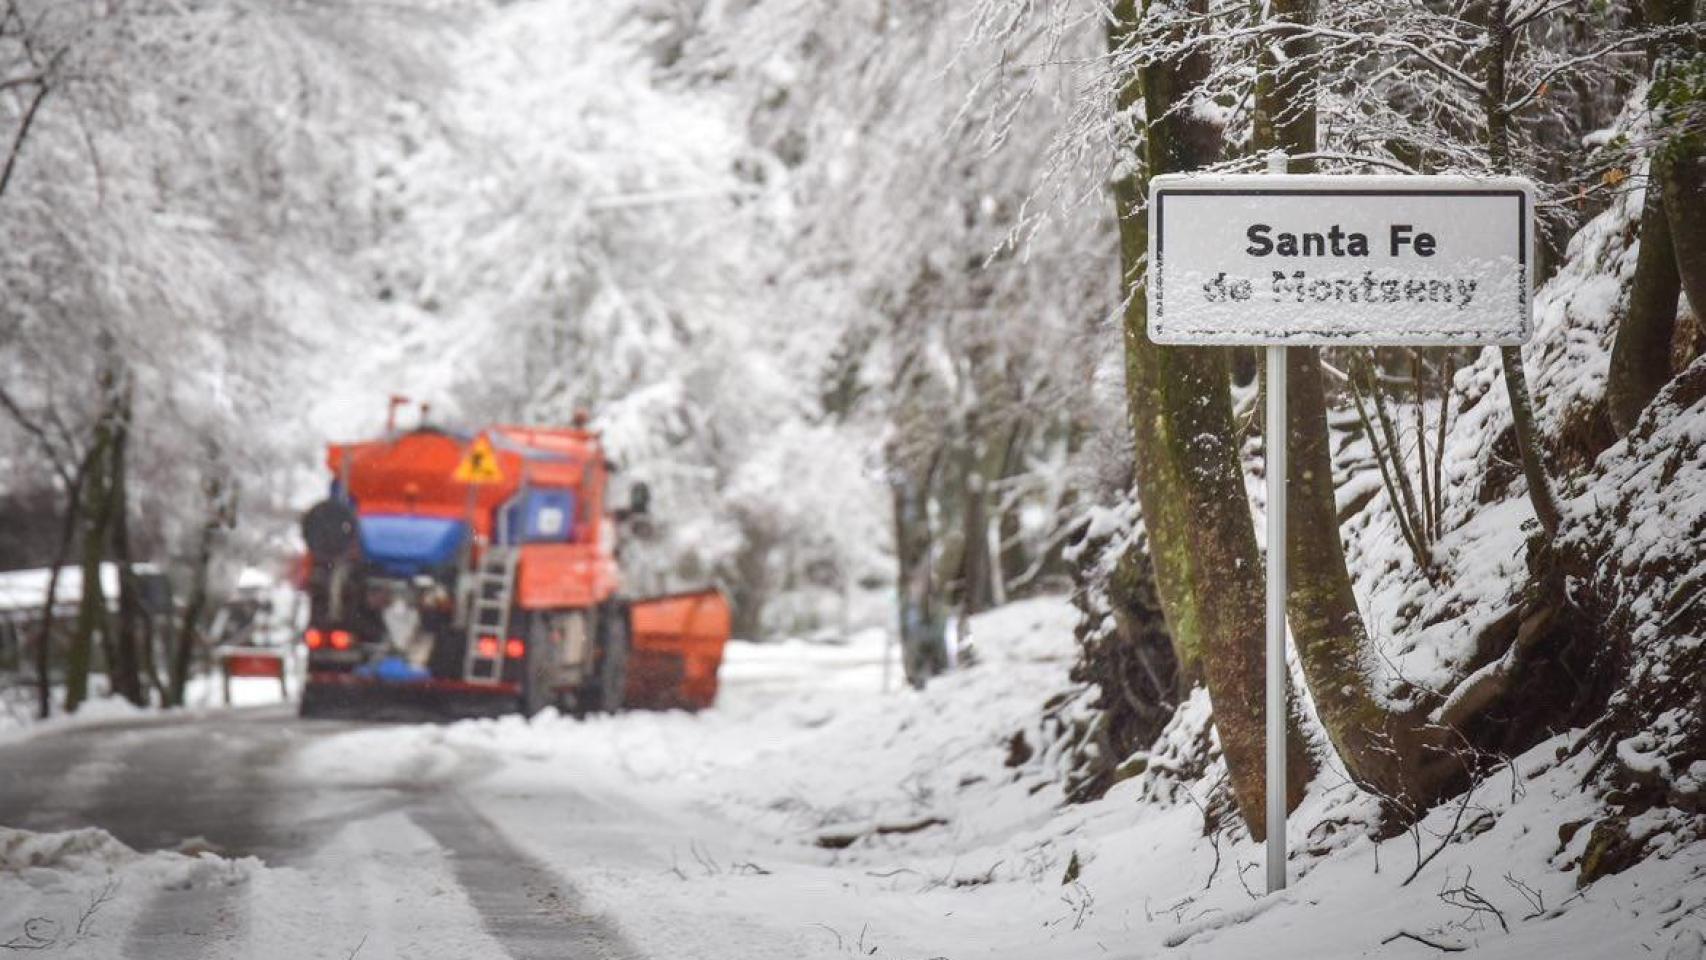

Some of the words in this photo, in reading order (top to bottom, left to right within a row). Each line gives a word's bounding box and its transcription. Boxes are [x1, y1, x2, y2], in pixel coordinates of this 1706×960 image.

[1246, 224, 1369, 257] Santa
[1390, 224, 1437, 257] Fe
[1203, 272, 1252, 303] de
[1272, 270, 1477, 311] Montseny
